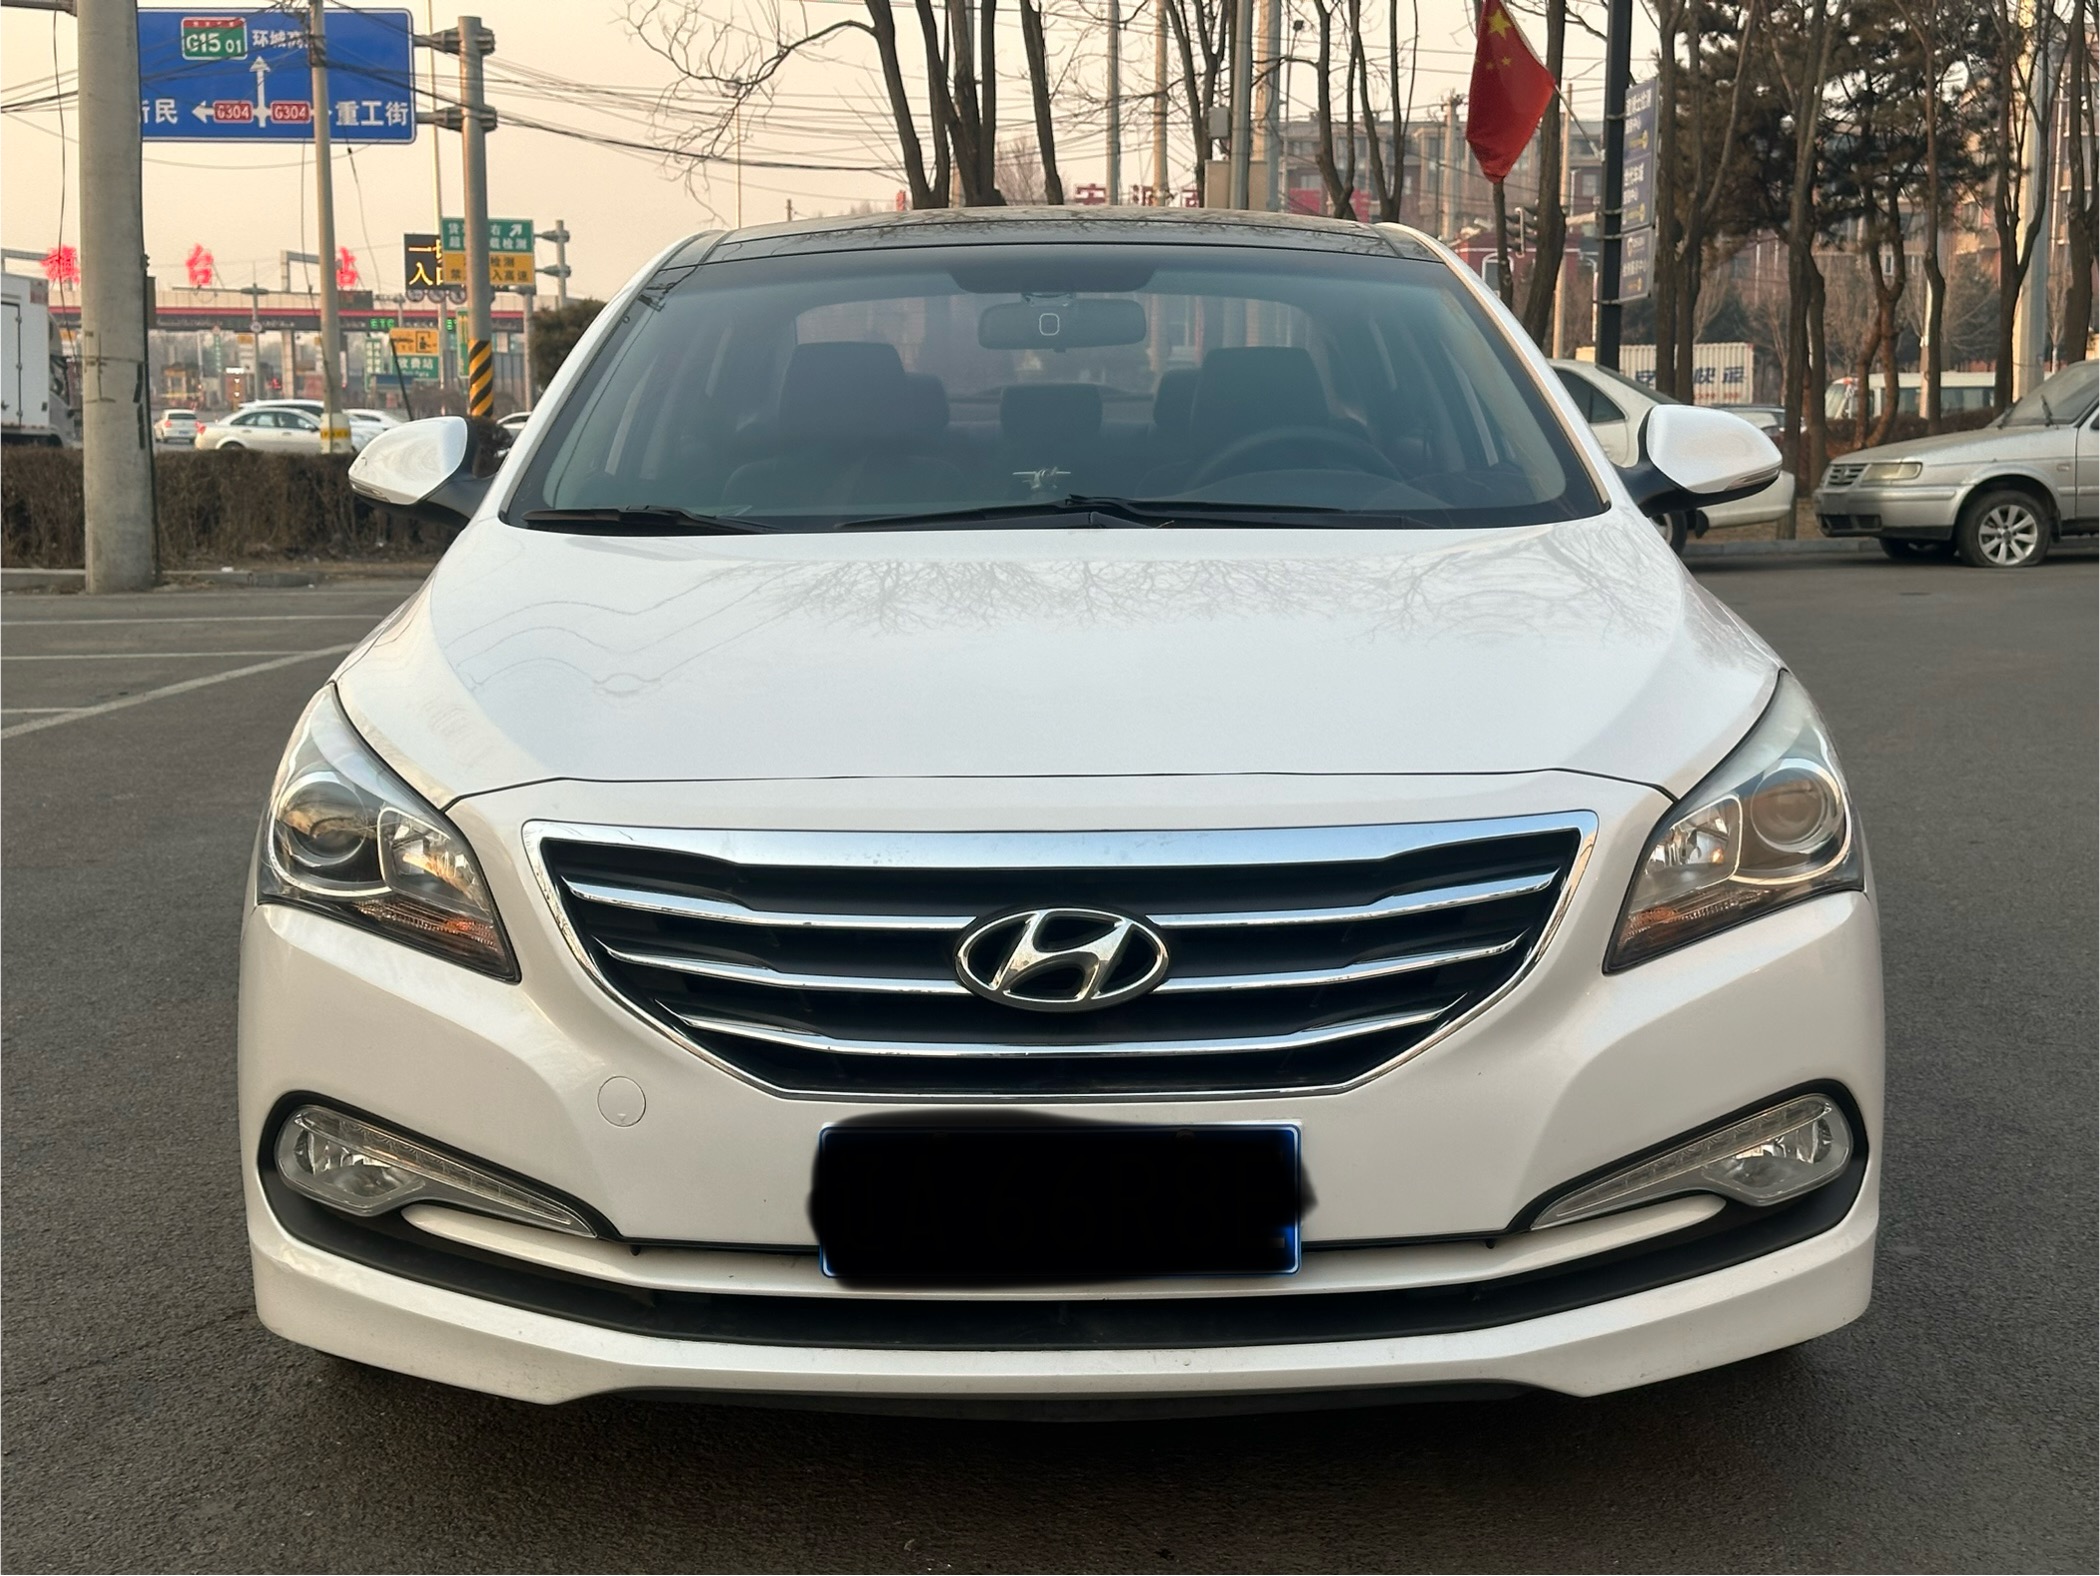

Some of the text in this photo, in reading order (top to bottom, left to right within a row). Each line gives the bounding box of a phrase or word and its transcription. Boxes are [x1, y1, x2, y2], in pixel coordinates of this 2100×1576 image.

[251, 28, 312, 50] 环城高
[216, 104, 250, 120] G304
[273, 104, 307, 120] G304
[335, 100, 409, 127] 重工街
[370, 318, 395, 329] ETC
